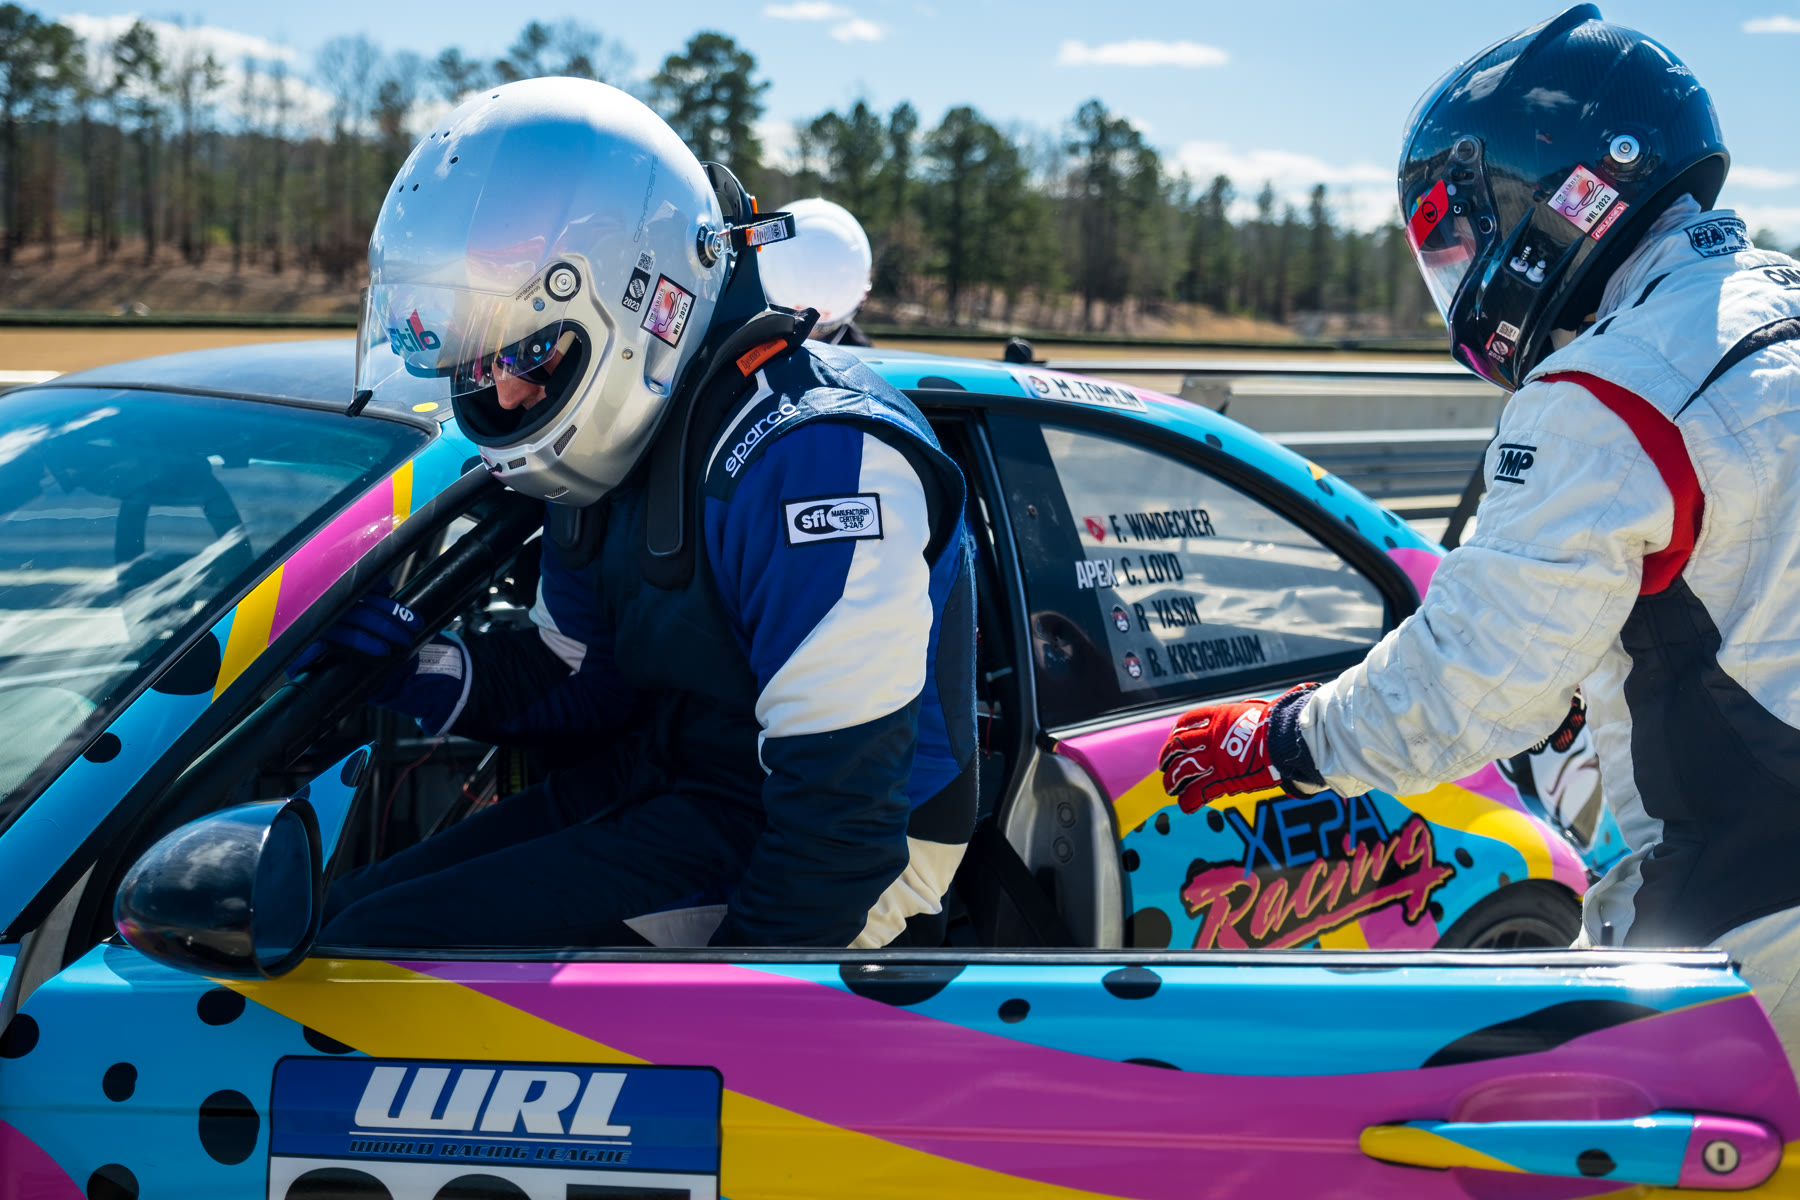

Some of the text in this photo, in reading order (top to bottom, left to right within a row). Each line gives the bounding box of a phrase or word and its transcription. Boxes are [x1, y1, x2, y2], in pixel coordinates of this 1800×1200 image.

[1585, 194, 1612, 224] WRL 2023
[1693, 226, 1723, 248] FIA
[623, 296, 640, 311] 2023
[672, 302, 689, 336] WRL 2023
[1073, 380, 1144, 408] TOMLIN
[725, 403, 797, 472] sparco
[801, 508, 827, 530] sfi
[831, 508, 870, 518] MANUFACTURER
[838, 515, 865, 523] CERTIFIED
[1108, 509, 1216, 544] F. WINDECKER
[1074, 559, 1118, 590] APEX
[1121, 553, 1184, 587] C. LOYD
[1152, 596, 1202, 629] YASIN
[1145, 634, 1267, 678] B. KREIGHBAUM
[1229, 790, 1390, 880] XEPA
[354, 1066, 632, 1137] WRL
[349, 1140, 632, 1165] WORLD RACING LEAGUE
